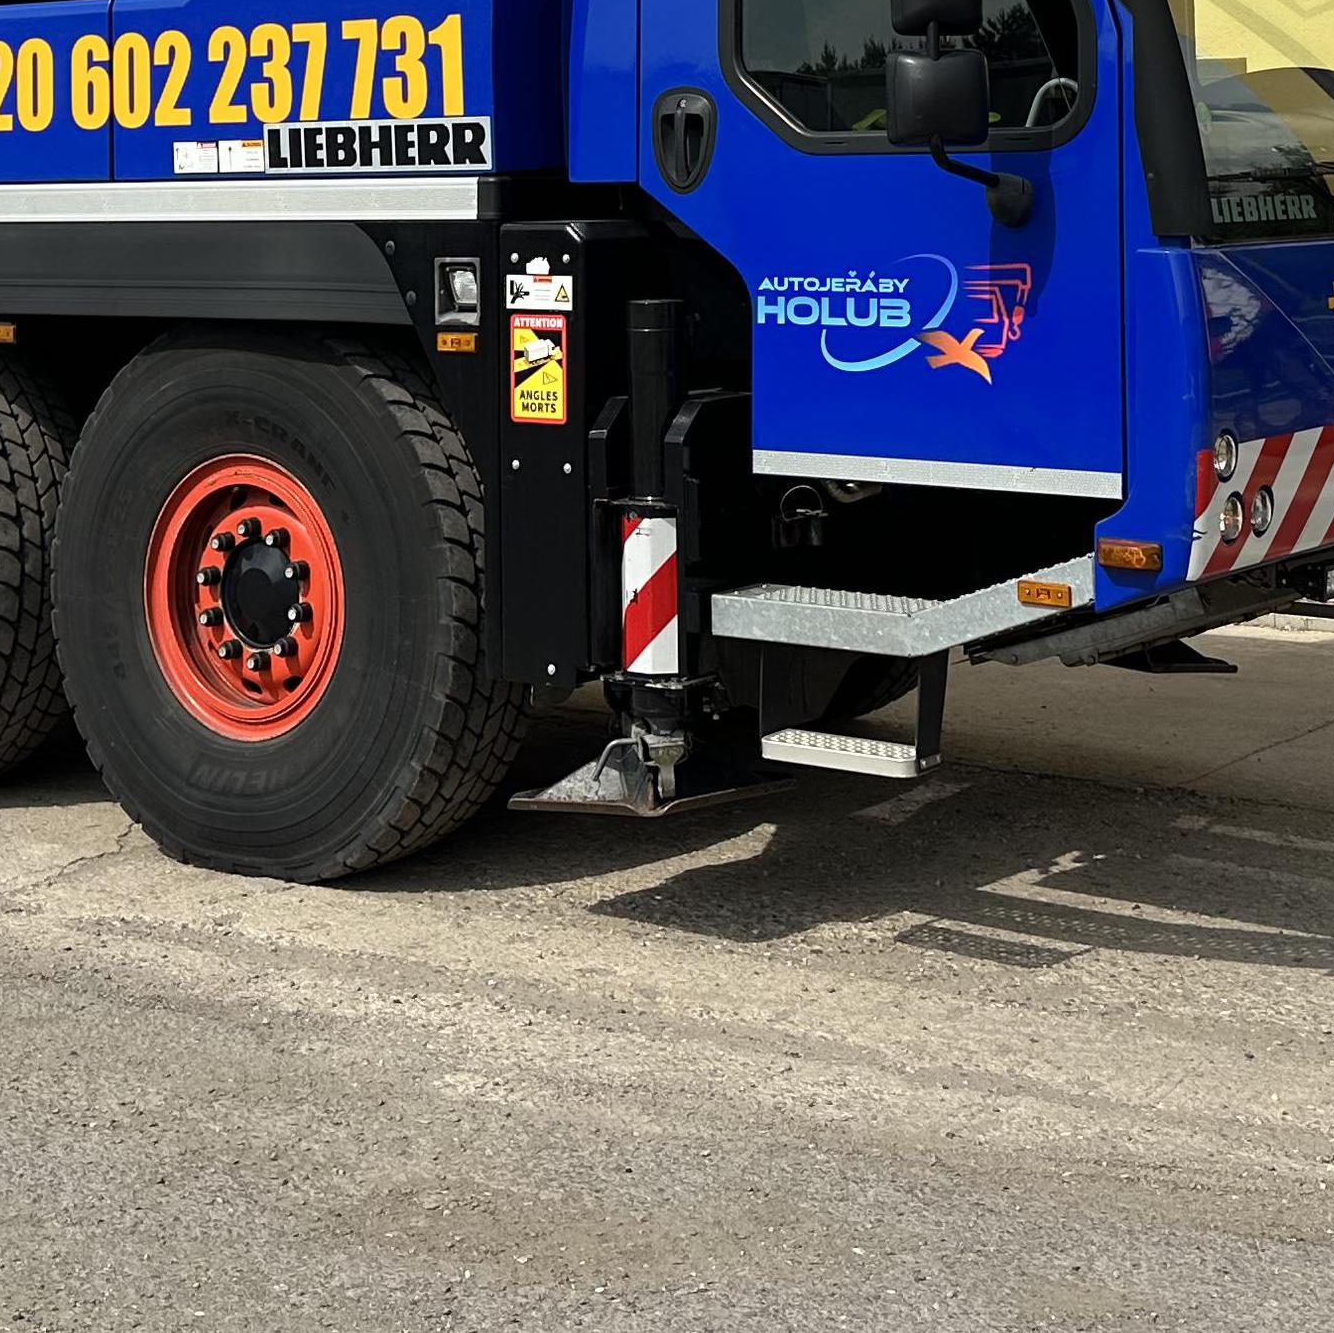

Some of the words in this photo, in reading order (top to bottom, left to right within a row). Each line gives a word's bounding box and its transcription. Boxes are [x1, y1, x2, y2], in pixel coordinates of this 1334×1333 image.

[71, 30, 191, 131] 602
[207, 20, 327, 125] 237
[341, 13, 464, 121] 731
[267, 122, 487, 169] LIEBHERR
[1210, 194, 1318, 224] LIEBHERR
[757, 270, 910, 294] AUTOJEŘÁBY
[513, 317, 563, 330] ATTENTION
[756, 296, 912, 328] HOLUB
[519, 390, 558, 402] ANGLES
[521, 402, 557, 414] MORTS
